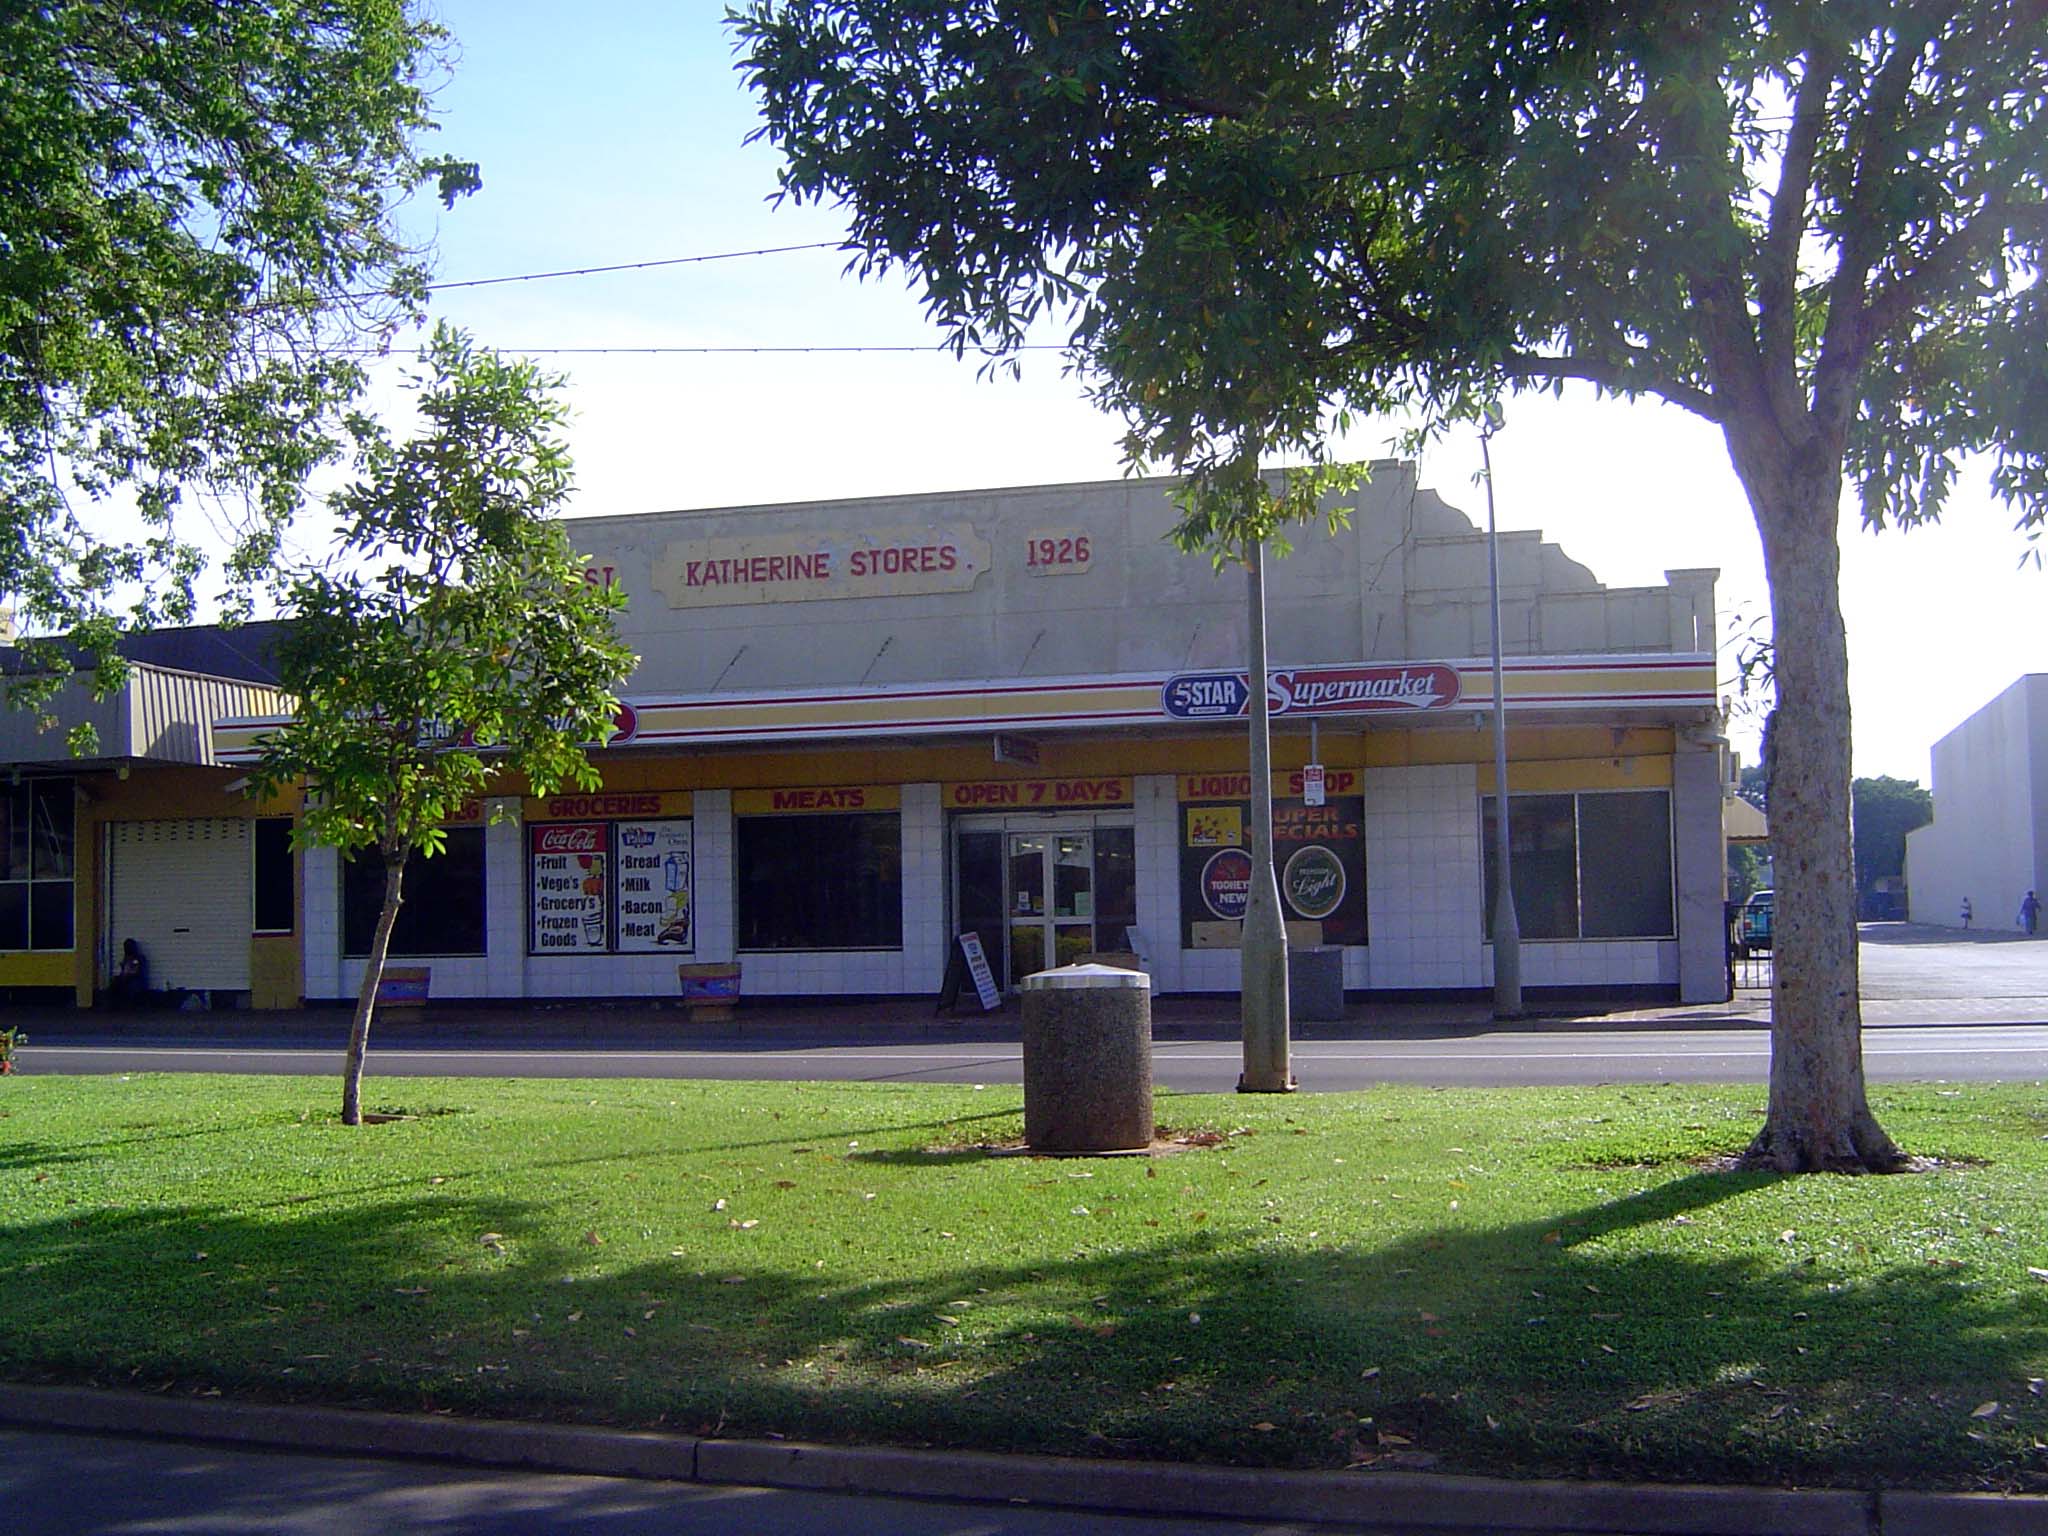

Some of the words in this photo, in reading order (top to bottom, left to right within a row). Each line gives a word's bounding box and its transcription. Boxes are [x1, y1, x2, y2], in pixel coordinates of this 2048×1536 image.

[1026, 537, 1090, 567] 1926
[685, 553, 830, 587] KATHERINE
[1267, 671, 1436, 715] Supermarket
[955, 783, 1018, 805] OPEN
[1026, 782, 1048, 803] 7
[1056, 780, 1124, 802] DAYS
[1188, 774, 1252, 798] LIQUO
[1289, 771, 1355, 795] SOP
[550, 796, 662, 817] GROCERIES
[773, 789, 865, 810] MEATS
[1272, 806, 1341, 824] UPER
[541, 856, 567, 870] Fruit
[625, 853, 661, 869] Bread
[541, 876, 579, 891] Vege's
[625, 877, 651, 892] Milk
[1211, 880, 1250, 891] TOOHEY
[1292, 872, 1337, 897] Light
[541, 896, 596, 912] Grocery's
[625, 900, 663, 914] Bacon
[1219, 893, 1248, 905] NEW
[541, 916, 578, 930] Frozen
[625, 922, 656, 937] Meat
[541, 932, 577, 947] Goods
